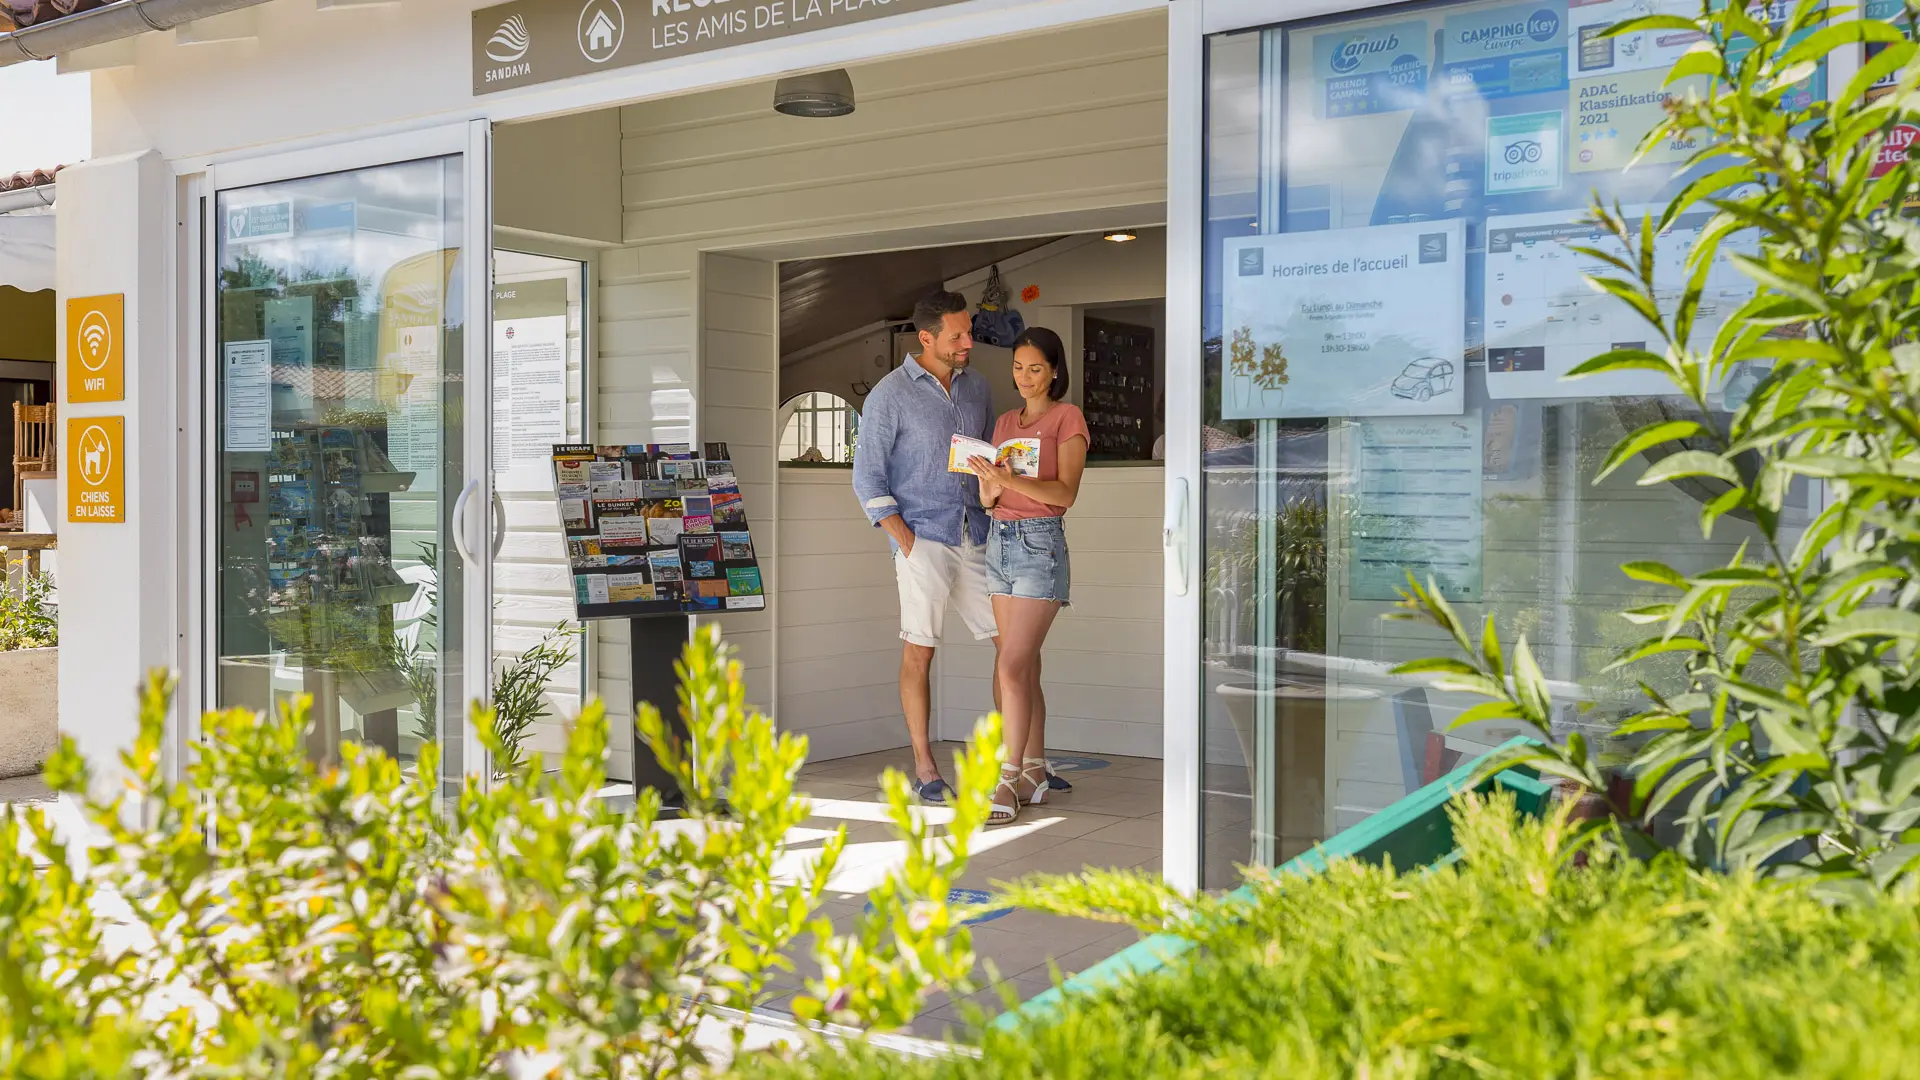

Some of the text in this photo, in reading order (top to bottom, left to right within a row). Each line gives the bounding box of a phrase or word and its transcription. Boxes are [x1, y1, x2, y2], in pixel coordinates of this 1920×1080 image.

[652, 21, 689, 49] LES
[695, 9, 747, 41] AMIS
[754, 2, 785, 29] DE
[792, 0, 822, 22] LA
[1460, 18, 1556, 44] CAMPING Key
[1344, 33, 1399, 56] anwb
[1483, 37, 1525, 51] Europe
[485, 62, 531, 83] SANDAYA
[1390, 69, 1421, 87] 2021
[1330, 78, 1368, 91] ERKENDE
[1579, 83, 1618, 99] ADAC
[1329, 87, 1369, 100] CAMPING
[1579, 112, 1610, 126] 2021
[1669, 140, 1697, 152] ADAC
[1272, 254, 1409, 279] Horaires de l'accueil
[496, 290, 517, 300] PLAGE
[1345, 299, 1384, 311] Dimanche
[84, 377, 105, 392] WIFI
[80, 491, 110, 504] CHIENS
[76, 505, 115, 518] EN LAISSE
